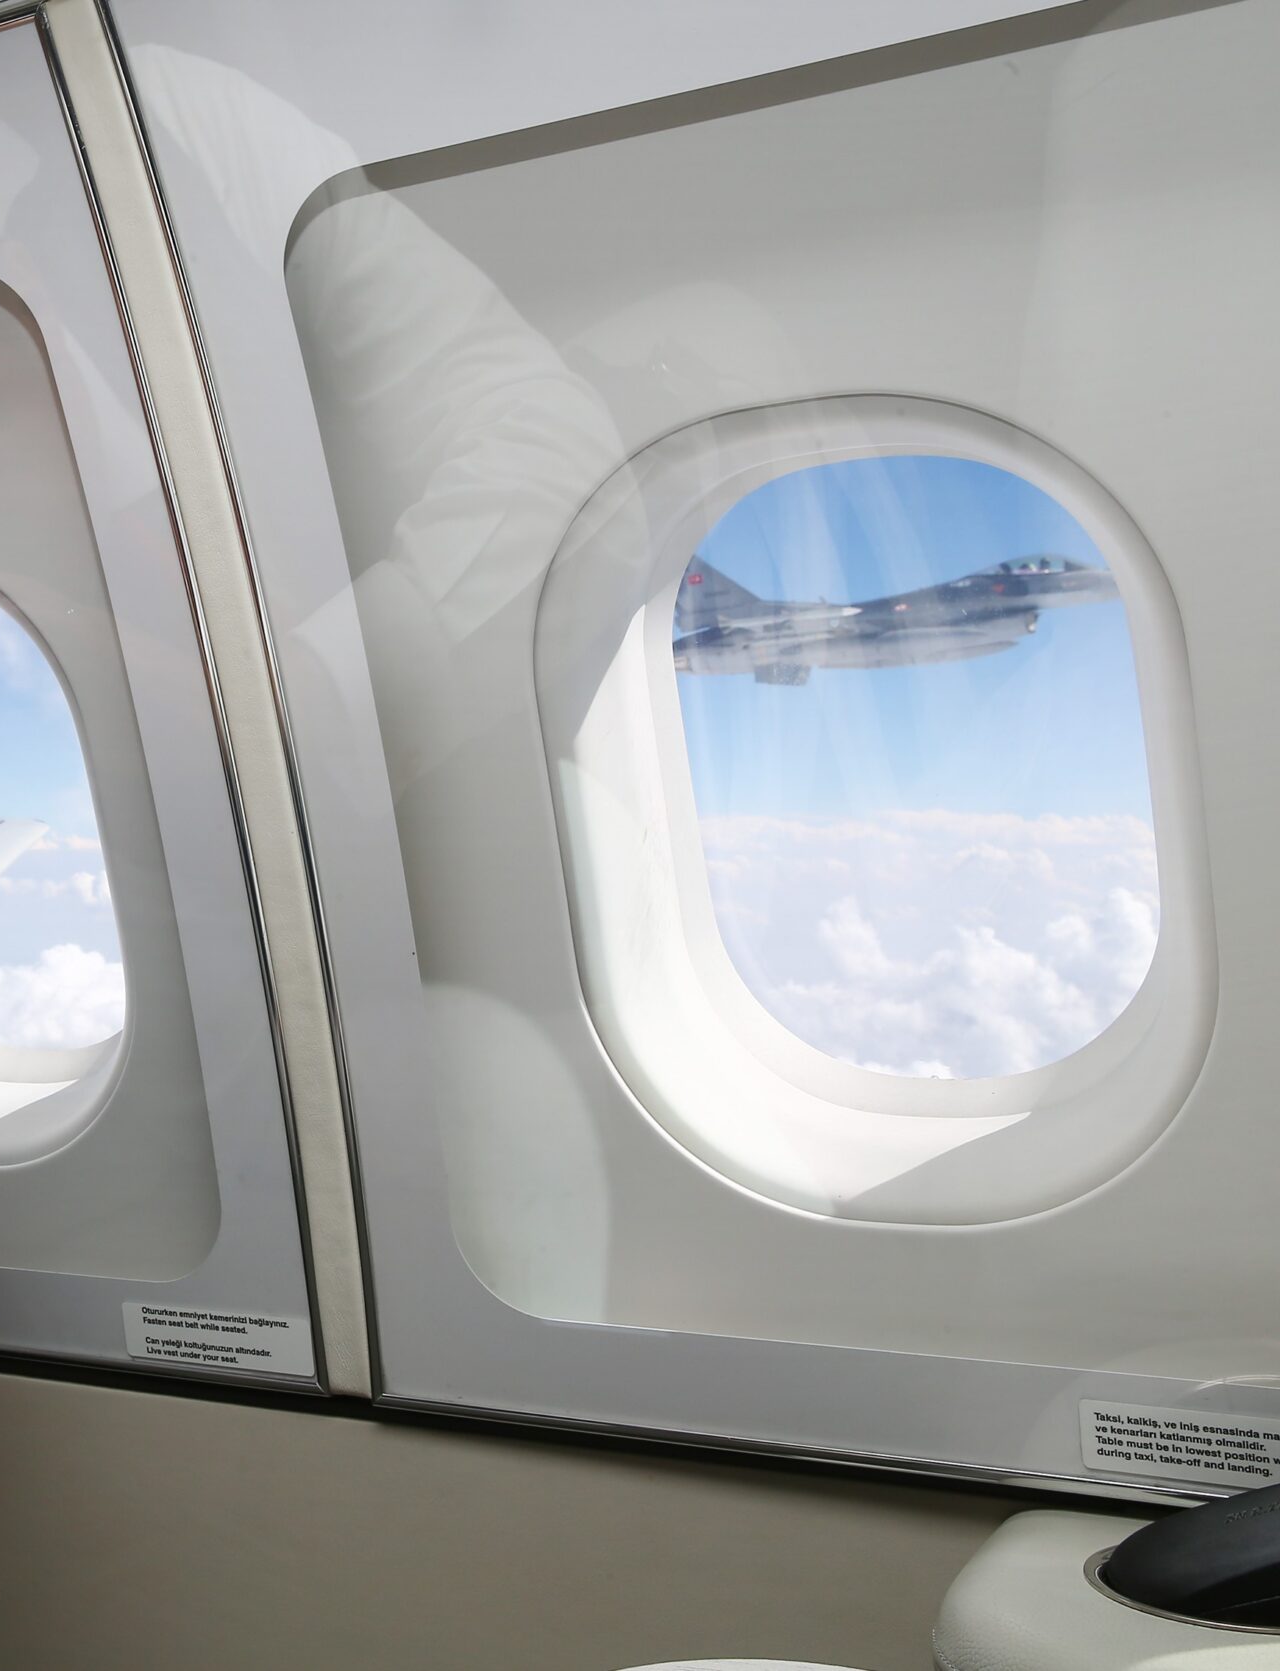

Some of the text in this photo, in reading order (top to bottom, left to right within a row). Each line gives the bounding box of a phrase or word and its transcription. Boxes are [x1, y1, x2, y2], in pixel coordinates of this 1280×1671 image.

[142, 1306, 178, 1317] Otururken
[179, 1312, 208, 1321] emniyet
[143, 1316, 166, 1326] Fasten
[185, 1321, 199, 1329] belt
[200, 1323, 220, 1331] while
[221, 1326, 248, 1334] seated.
[146, 1336, 160, 1344] Can
[1094, 1412, 1124, 1424] Taksi,
[1164, 1421, 1177, 1429] ve
[1180, 1421, 1200, 1433] iniş
[1096, 1435, 1123, 1446] Table
[1126, 1440, 1153, 1450] must
[1156, 1442, 1169, 1451] be
[1172, 1444, 1182, 1453] in
[1186, 1446, 1221, 1458] lowest
[1224, 1452, 1270, 1463] position
[1097, 1448, 1273, 1477] during taxi, take-off and landing.
